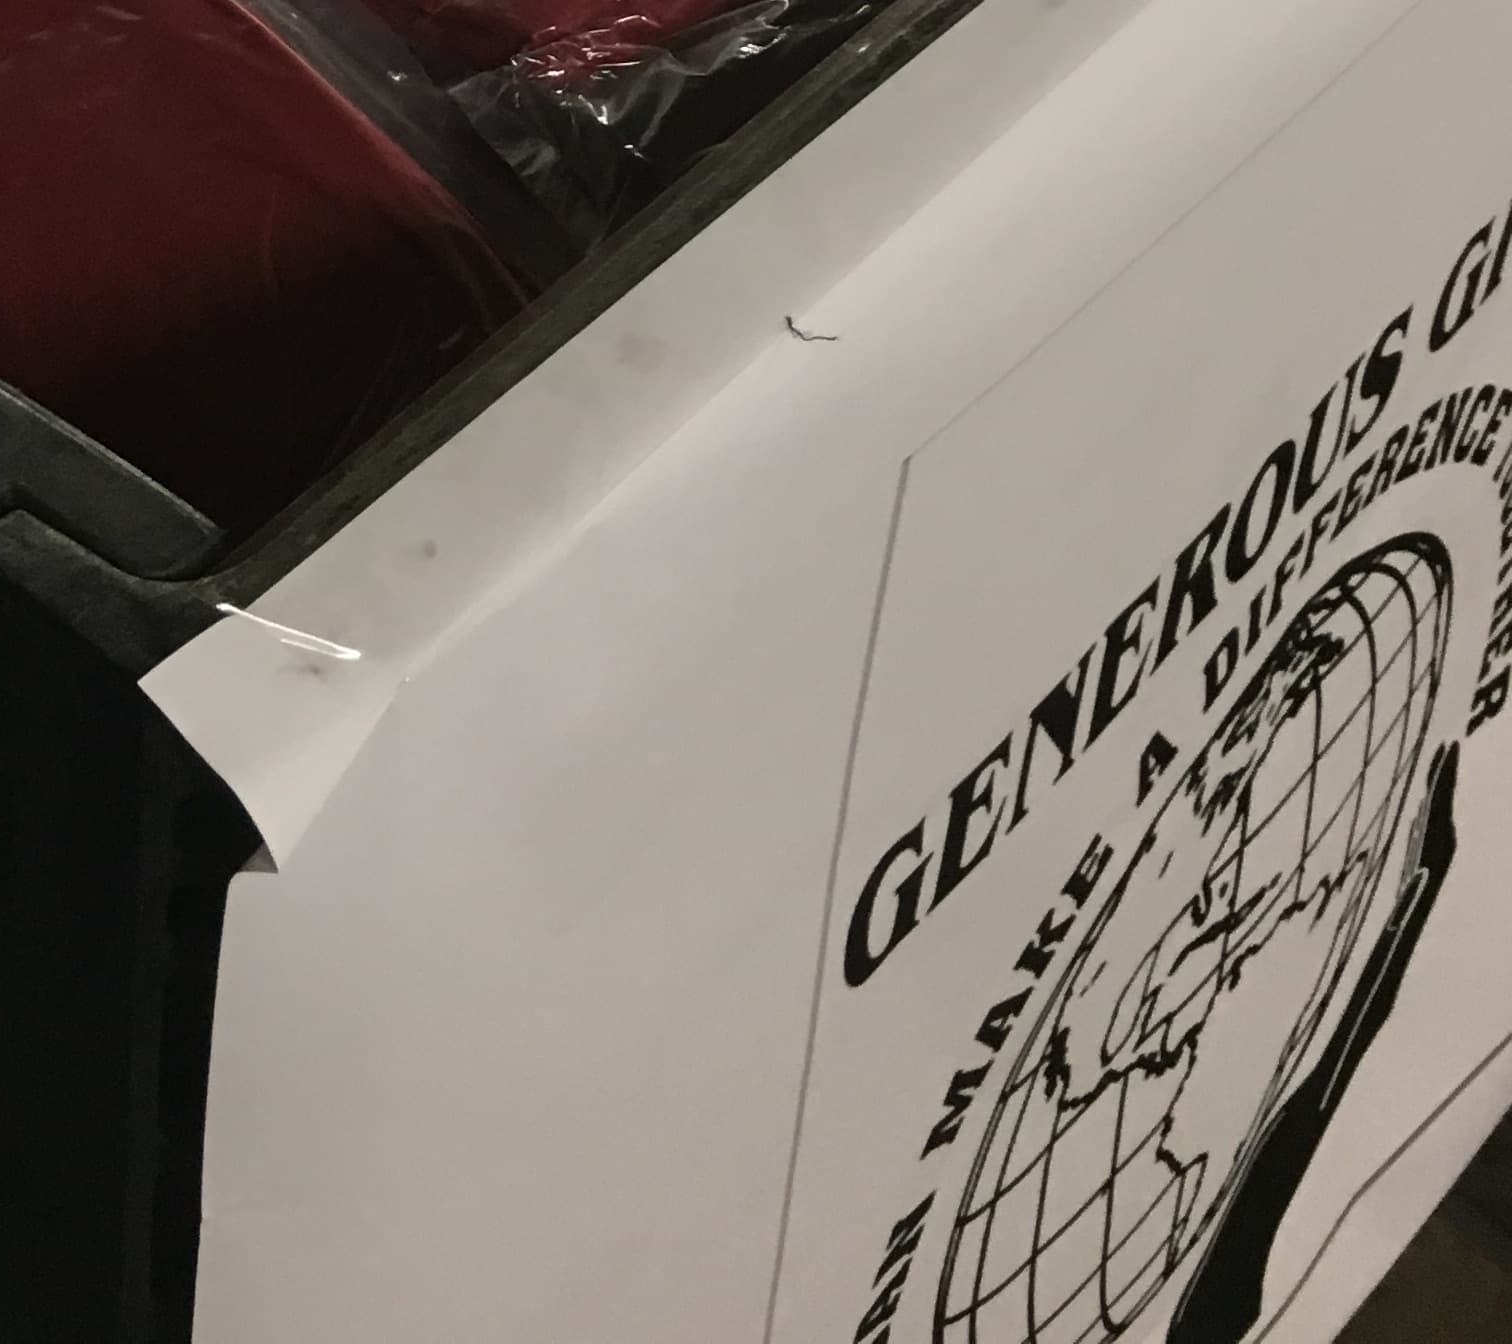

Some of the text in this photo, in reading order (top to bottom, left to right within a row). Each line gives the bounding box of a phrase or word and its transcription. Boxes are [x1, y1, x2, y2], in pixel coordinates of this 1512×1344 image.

[842, 303, 1414, 988] GENEROUS
[852, 1189, 937, 1344] AN
[919, 832, 1115, 1161] MAKE
[1135, 730, 1180, 807] A
[1202, 382, 1512, 714] DIFFERENCE
